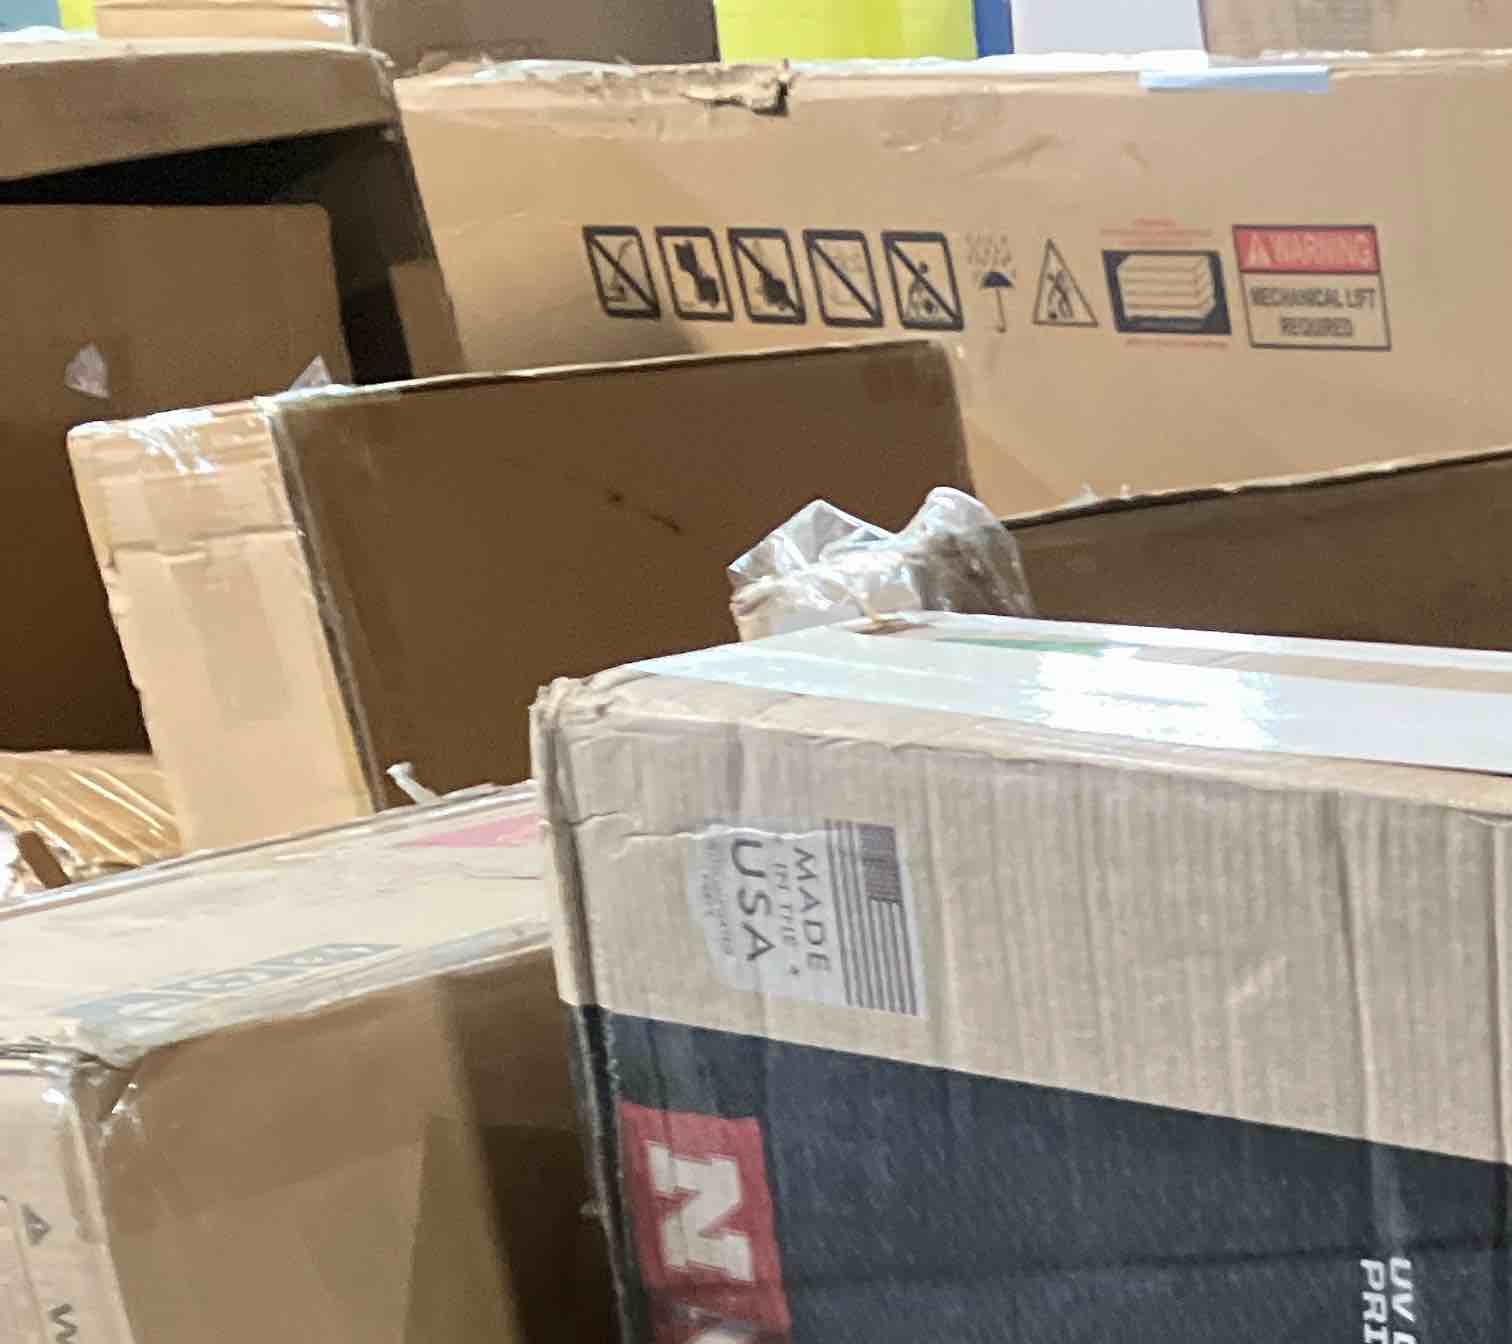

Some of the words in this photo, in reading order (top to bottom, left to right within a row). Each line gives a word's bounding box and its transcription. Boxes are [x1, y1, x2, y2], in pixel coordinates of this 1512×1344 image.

[1344, 287, 1377, 310] LIFT
[730, 837, 777, 962] USA
[794, 847, 832, 973] MADE
[1389, 1256, 1416, 1324] UV
